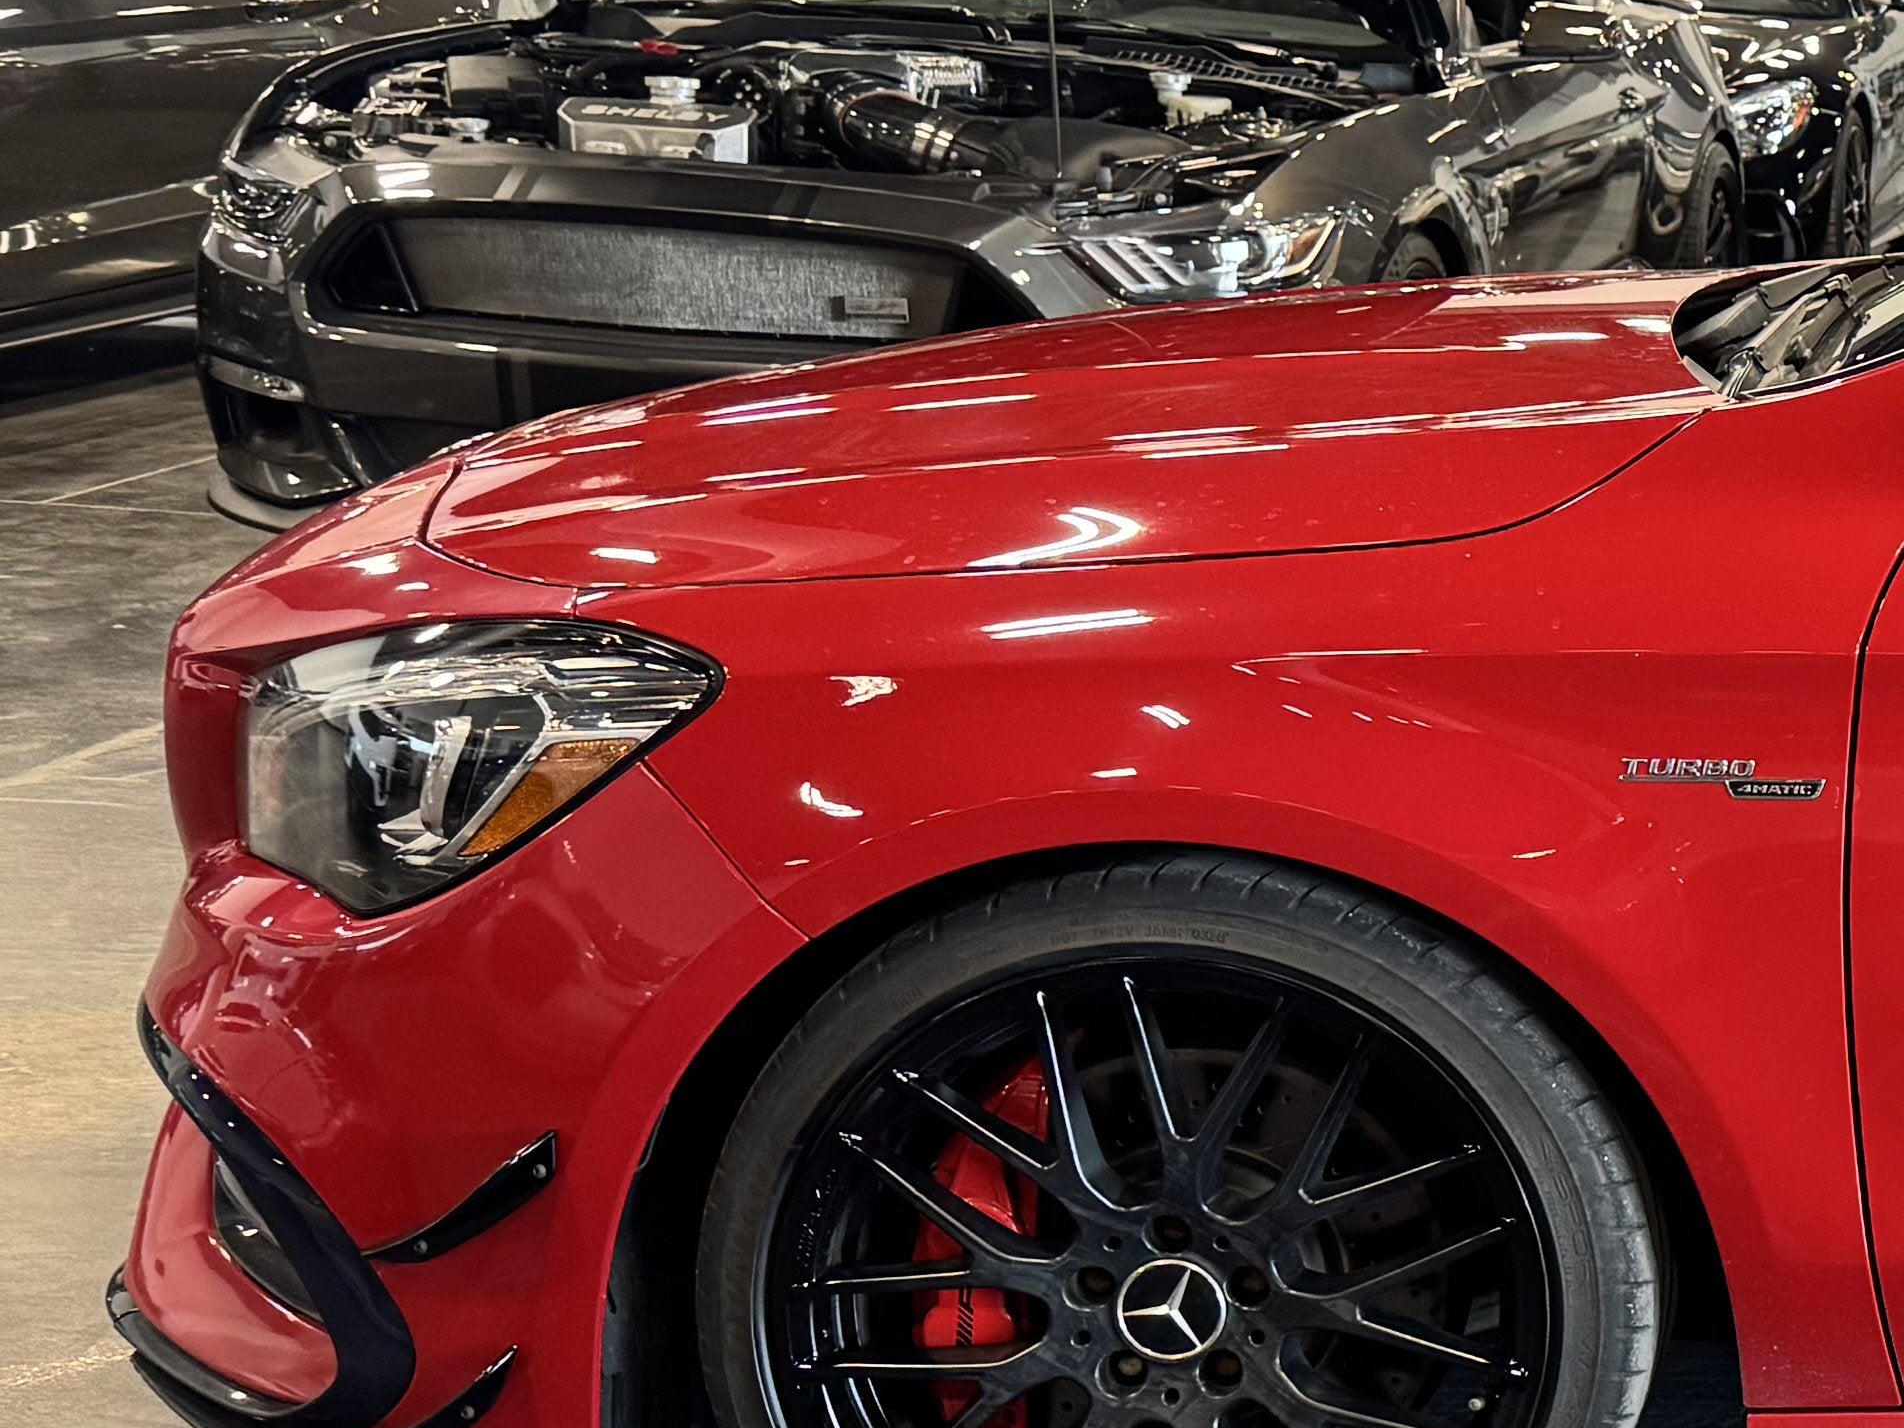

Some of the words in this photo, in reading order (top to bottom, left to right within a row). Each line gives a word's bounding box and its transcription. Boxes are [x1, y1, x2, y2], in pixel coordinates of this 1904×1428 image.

[581, 104, 731, 122] SHELBY
[1621, 758, 1756, 777] TURBO
[1737, 784, 1812, 795] 4MATIC
